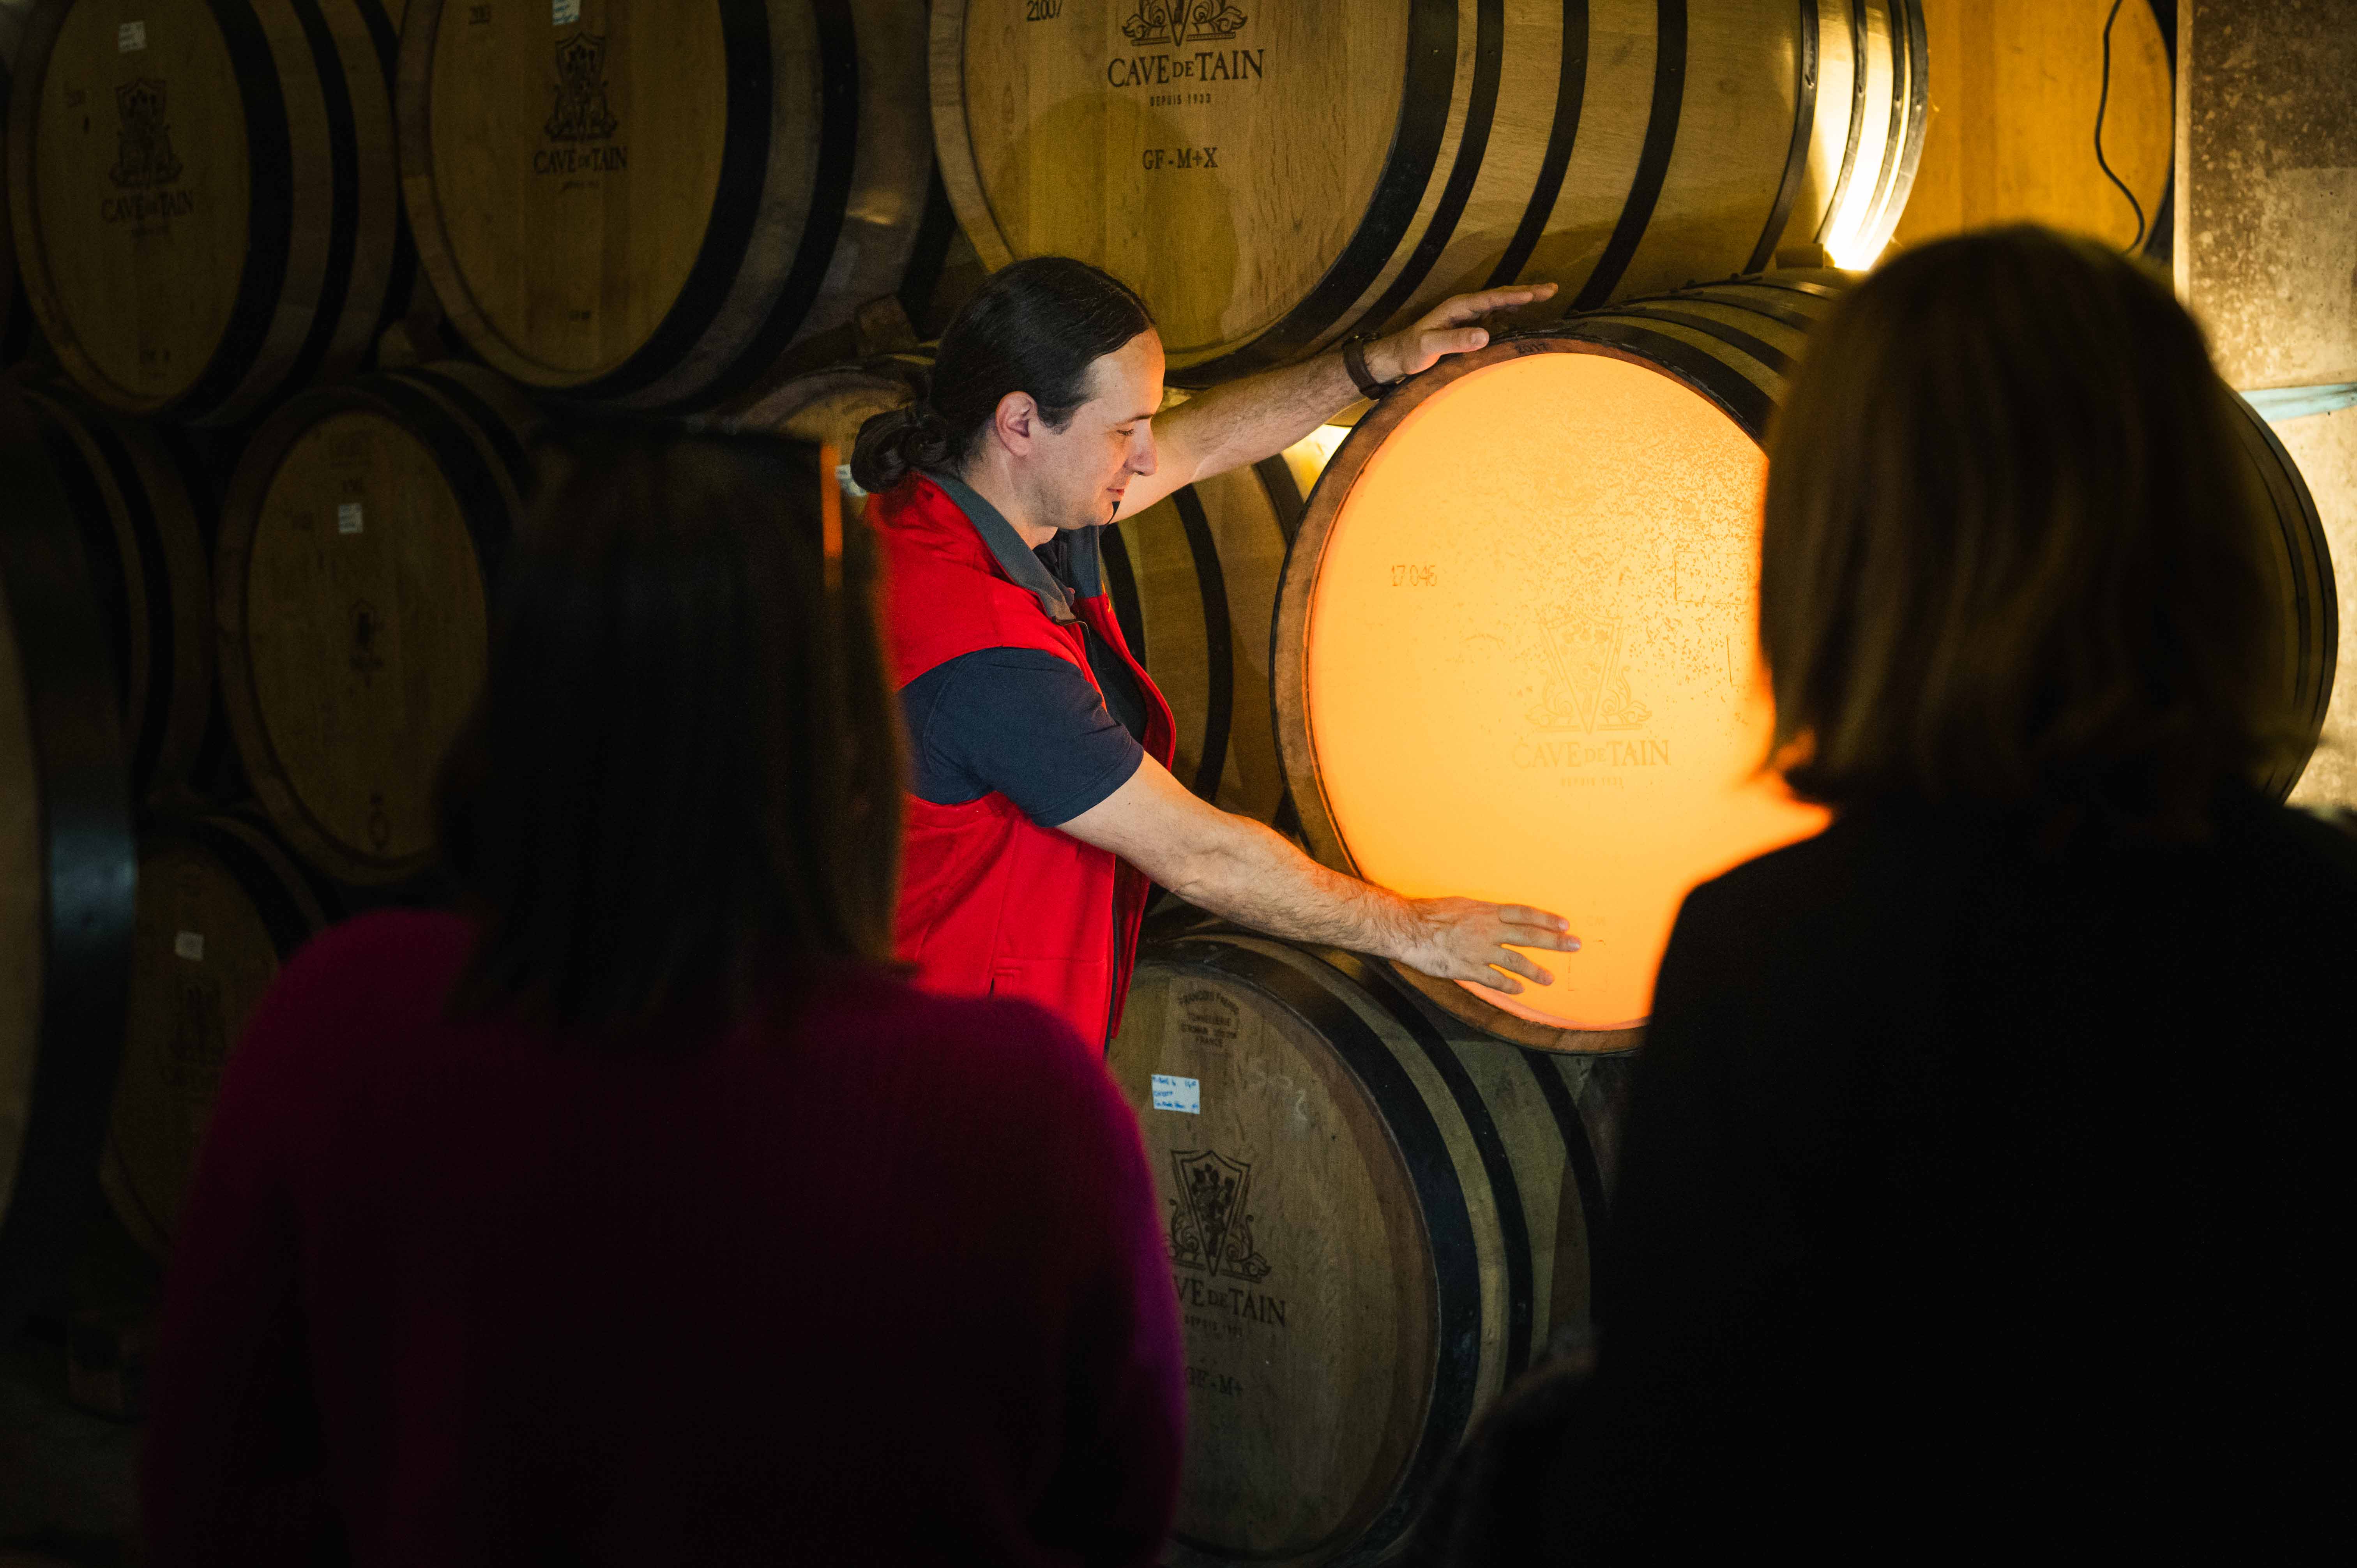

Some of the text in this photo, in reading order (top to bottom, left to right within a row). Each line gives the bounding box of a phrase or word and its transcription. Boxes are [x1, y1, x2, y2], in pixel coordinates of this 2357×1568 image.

[1108, 49, 1264, 88] CAVE DE TAIN
[1150, 93, 1211, 106] DEPUIS 1933
[1511, 740, 1670, 769] CAVE DE TAIN
[1173, 1275, 1286, 1328] VE DE TAIN
